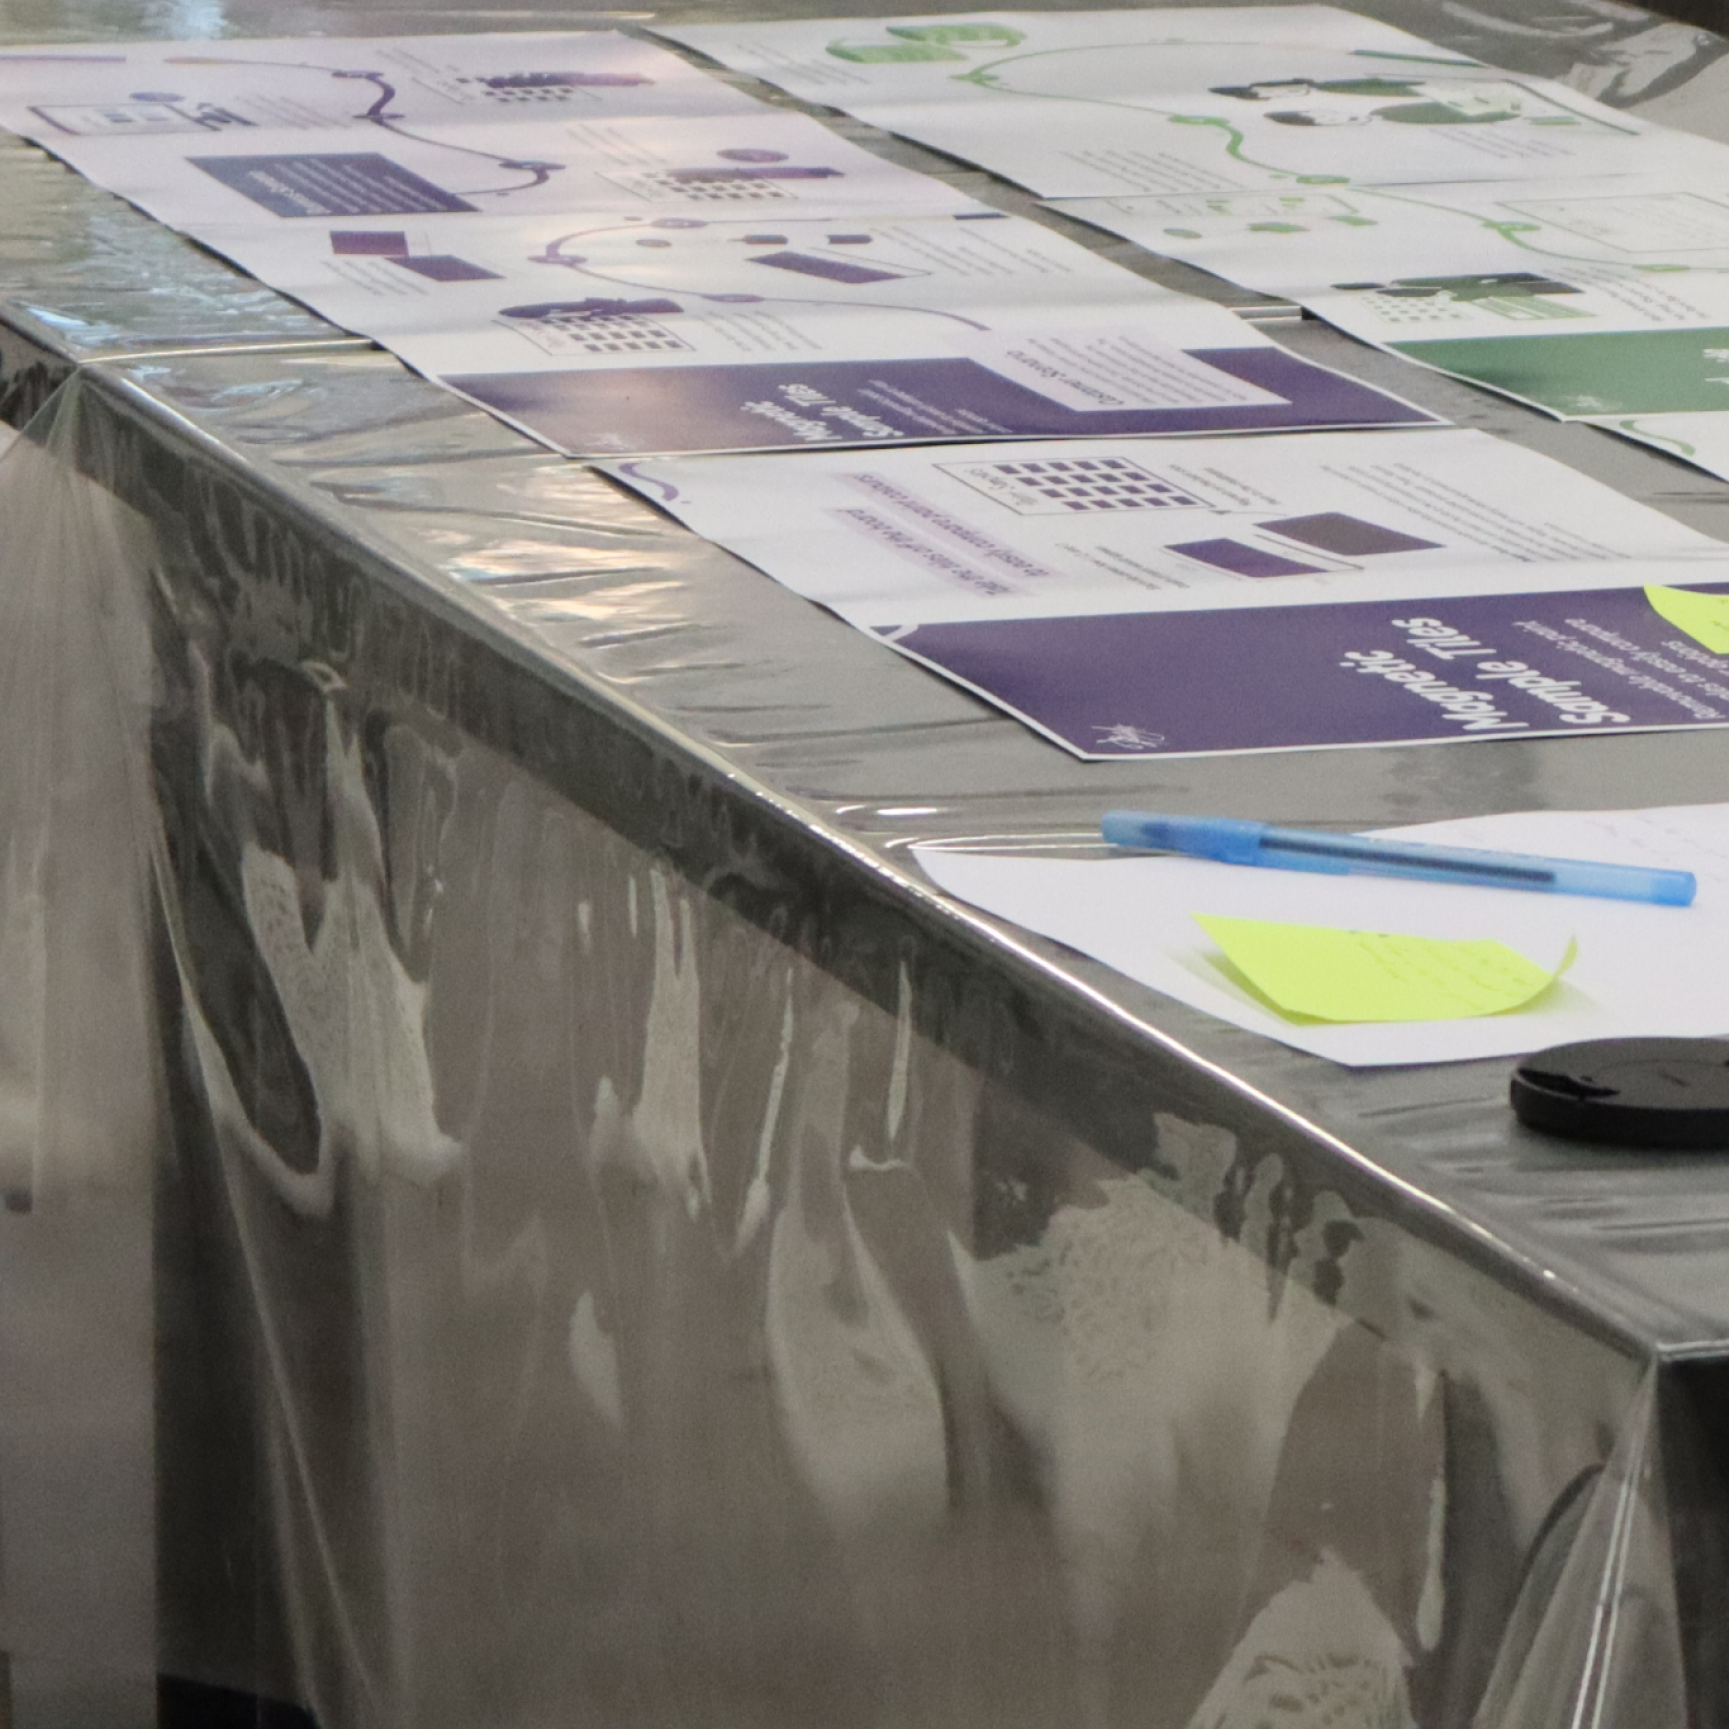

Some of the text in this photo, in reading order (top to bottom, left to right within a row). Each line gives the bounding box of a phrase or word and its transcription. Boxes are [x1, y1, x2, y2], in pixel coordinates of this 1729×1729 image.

[779, 383, 836, 407] Tiles
[741, 399, 843, 442] Magnetic
[820, 405, 906, 438] Sample
[1566, 619, 1640, 651] compare
[1392, 618, 1630, 724] Sample Tiles
[1515, 621, 1726, 720] Removable magnetic paint
[1629, 650, 1686, 674] easily
[1662, 641, 1728, 669] options
[1340, 650, 1528, 730] Magnetic
[1678, 673, 1705, 683] to
